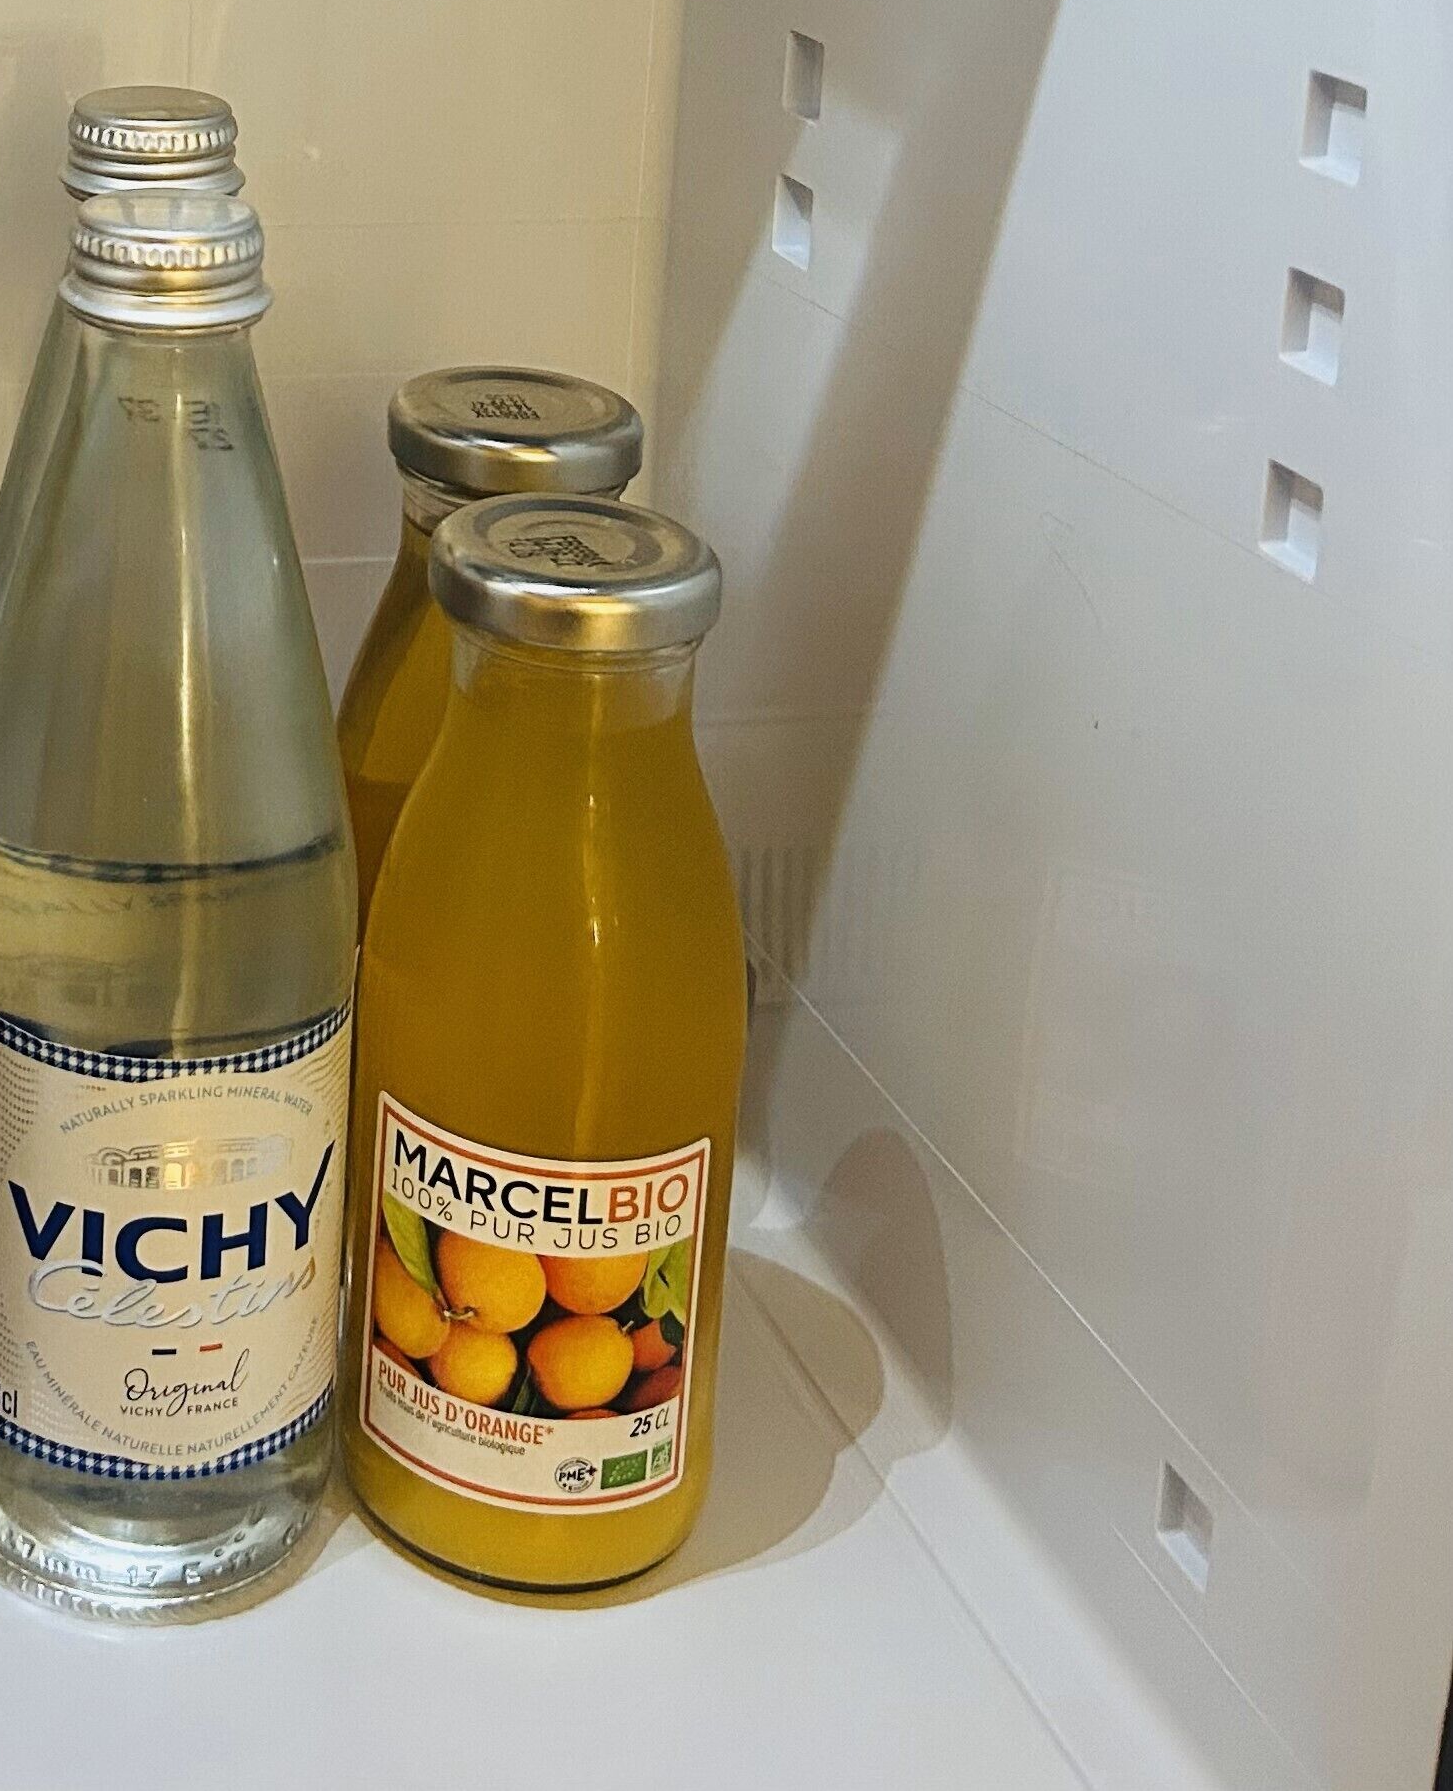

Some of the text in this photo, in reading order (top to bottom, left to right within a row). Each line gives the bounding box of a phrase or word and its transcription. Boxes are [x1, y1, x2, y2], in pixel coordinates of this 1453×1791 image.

[60, 1085, 314, 1134] NATURALLY SPARKLING MINERAL WATER
[8, 1139, 335, 1283] VICHY
[392, 1168, 682, 1249] 100% PUR JUS BIO
[27, 1340, 46, 1370] EAU
[44, 1371, 103, 1431] MINÉRALE
[102, 1427, 183, 1457] NATURELLE
[187, 1383, 288, 1455] NATURELLEMENT
[119, 1398, 238, 1418] VICHY FRANCE
[123, 1348, 250, 1417] Original
[378, 1359, 406, 1397] PUR
[410, 1384, 440, 1415] JUS
[630, 1413, 654, 1438] 25
